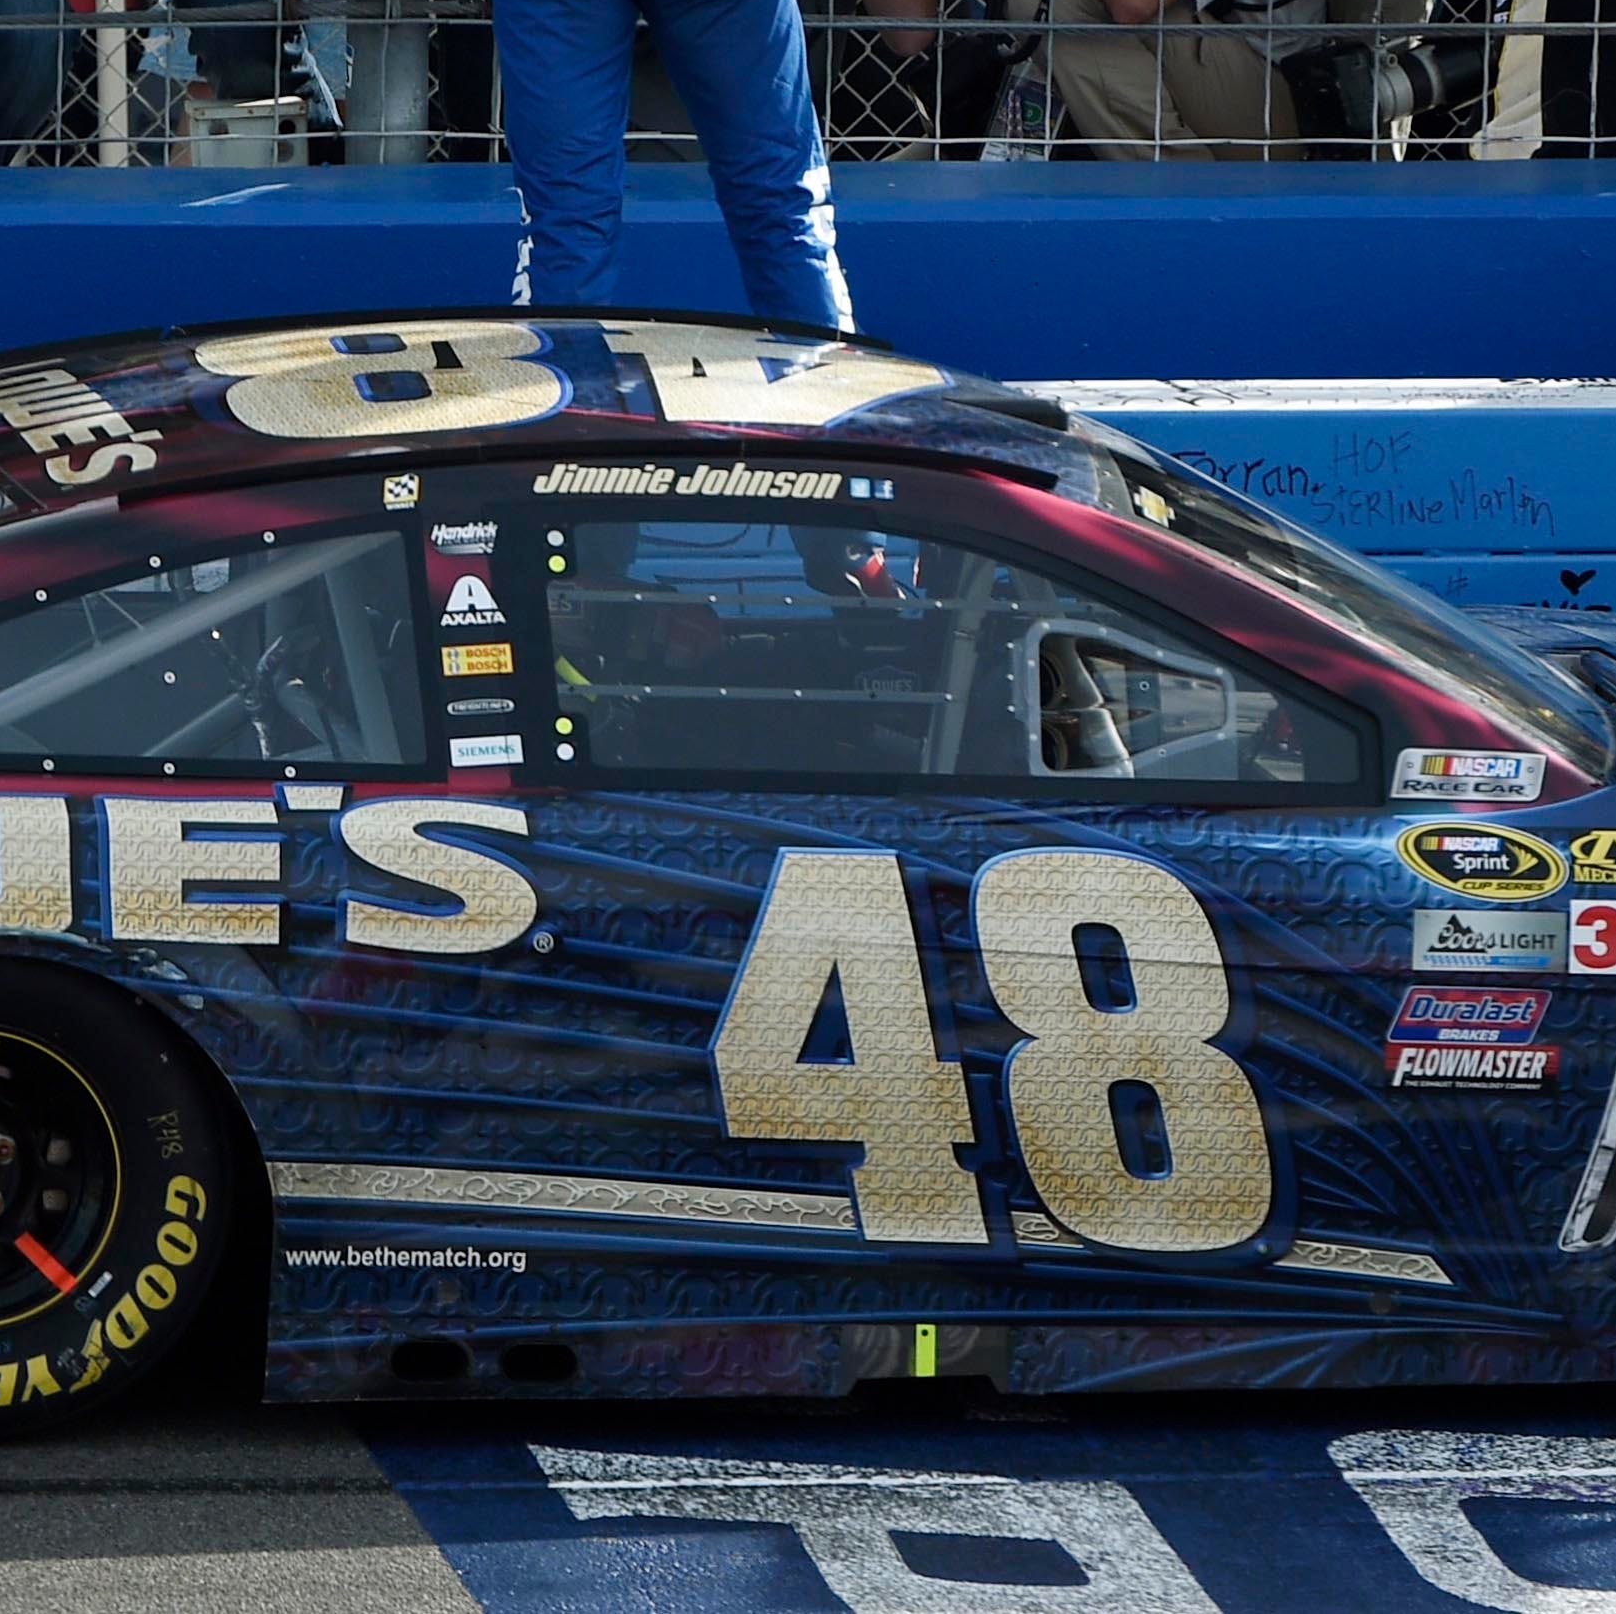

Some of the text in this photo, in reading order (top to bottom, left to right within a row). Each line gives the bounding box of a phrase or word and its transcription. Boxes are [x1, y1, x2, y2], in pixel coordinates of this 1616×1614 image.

[531, 463, 847, 500] Jimmie Johnson
[430, 521, 500, 546] Hendrick
[440, 610, 508, 627] AXALTA
[465, 646, 507, 659] BOSCH
[466, 659, 509, 672] BOSCH
[457, 744, 516, 758] SIEMENS
[1447, 755, 1521, 778] NASCAR
[1402, 778, 1525, 796] RACE CAR
[1442, 836, 1500, 851] NASCAR
[1452, 852, 1510, 874] Sprint
[1461, 879, 1546, 892] CUP SERIES
[1436, 924, 1557, 952] Coors LIGHT
[1409, 996, 1535, 1023] Duralast
[1437, 1029, 1500, 1042] BRAKES
[709, 846, 1276, 1253] 48
[1393, 1047, 1549, 1087] FLOWMASTER
[285, 1244, 528, 1274] www.bethematch.org
